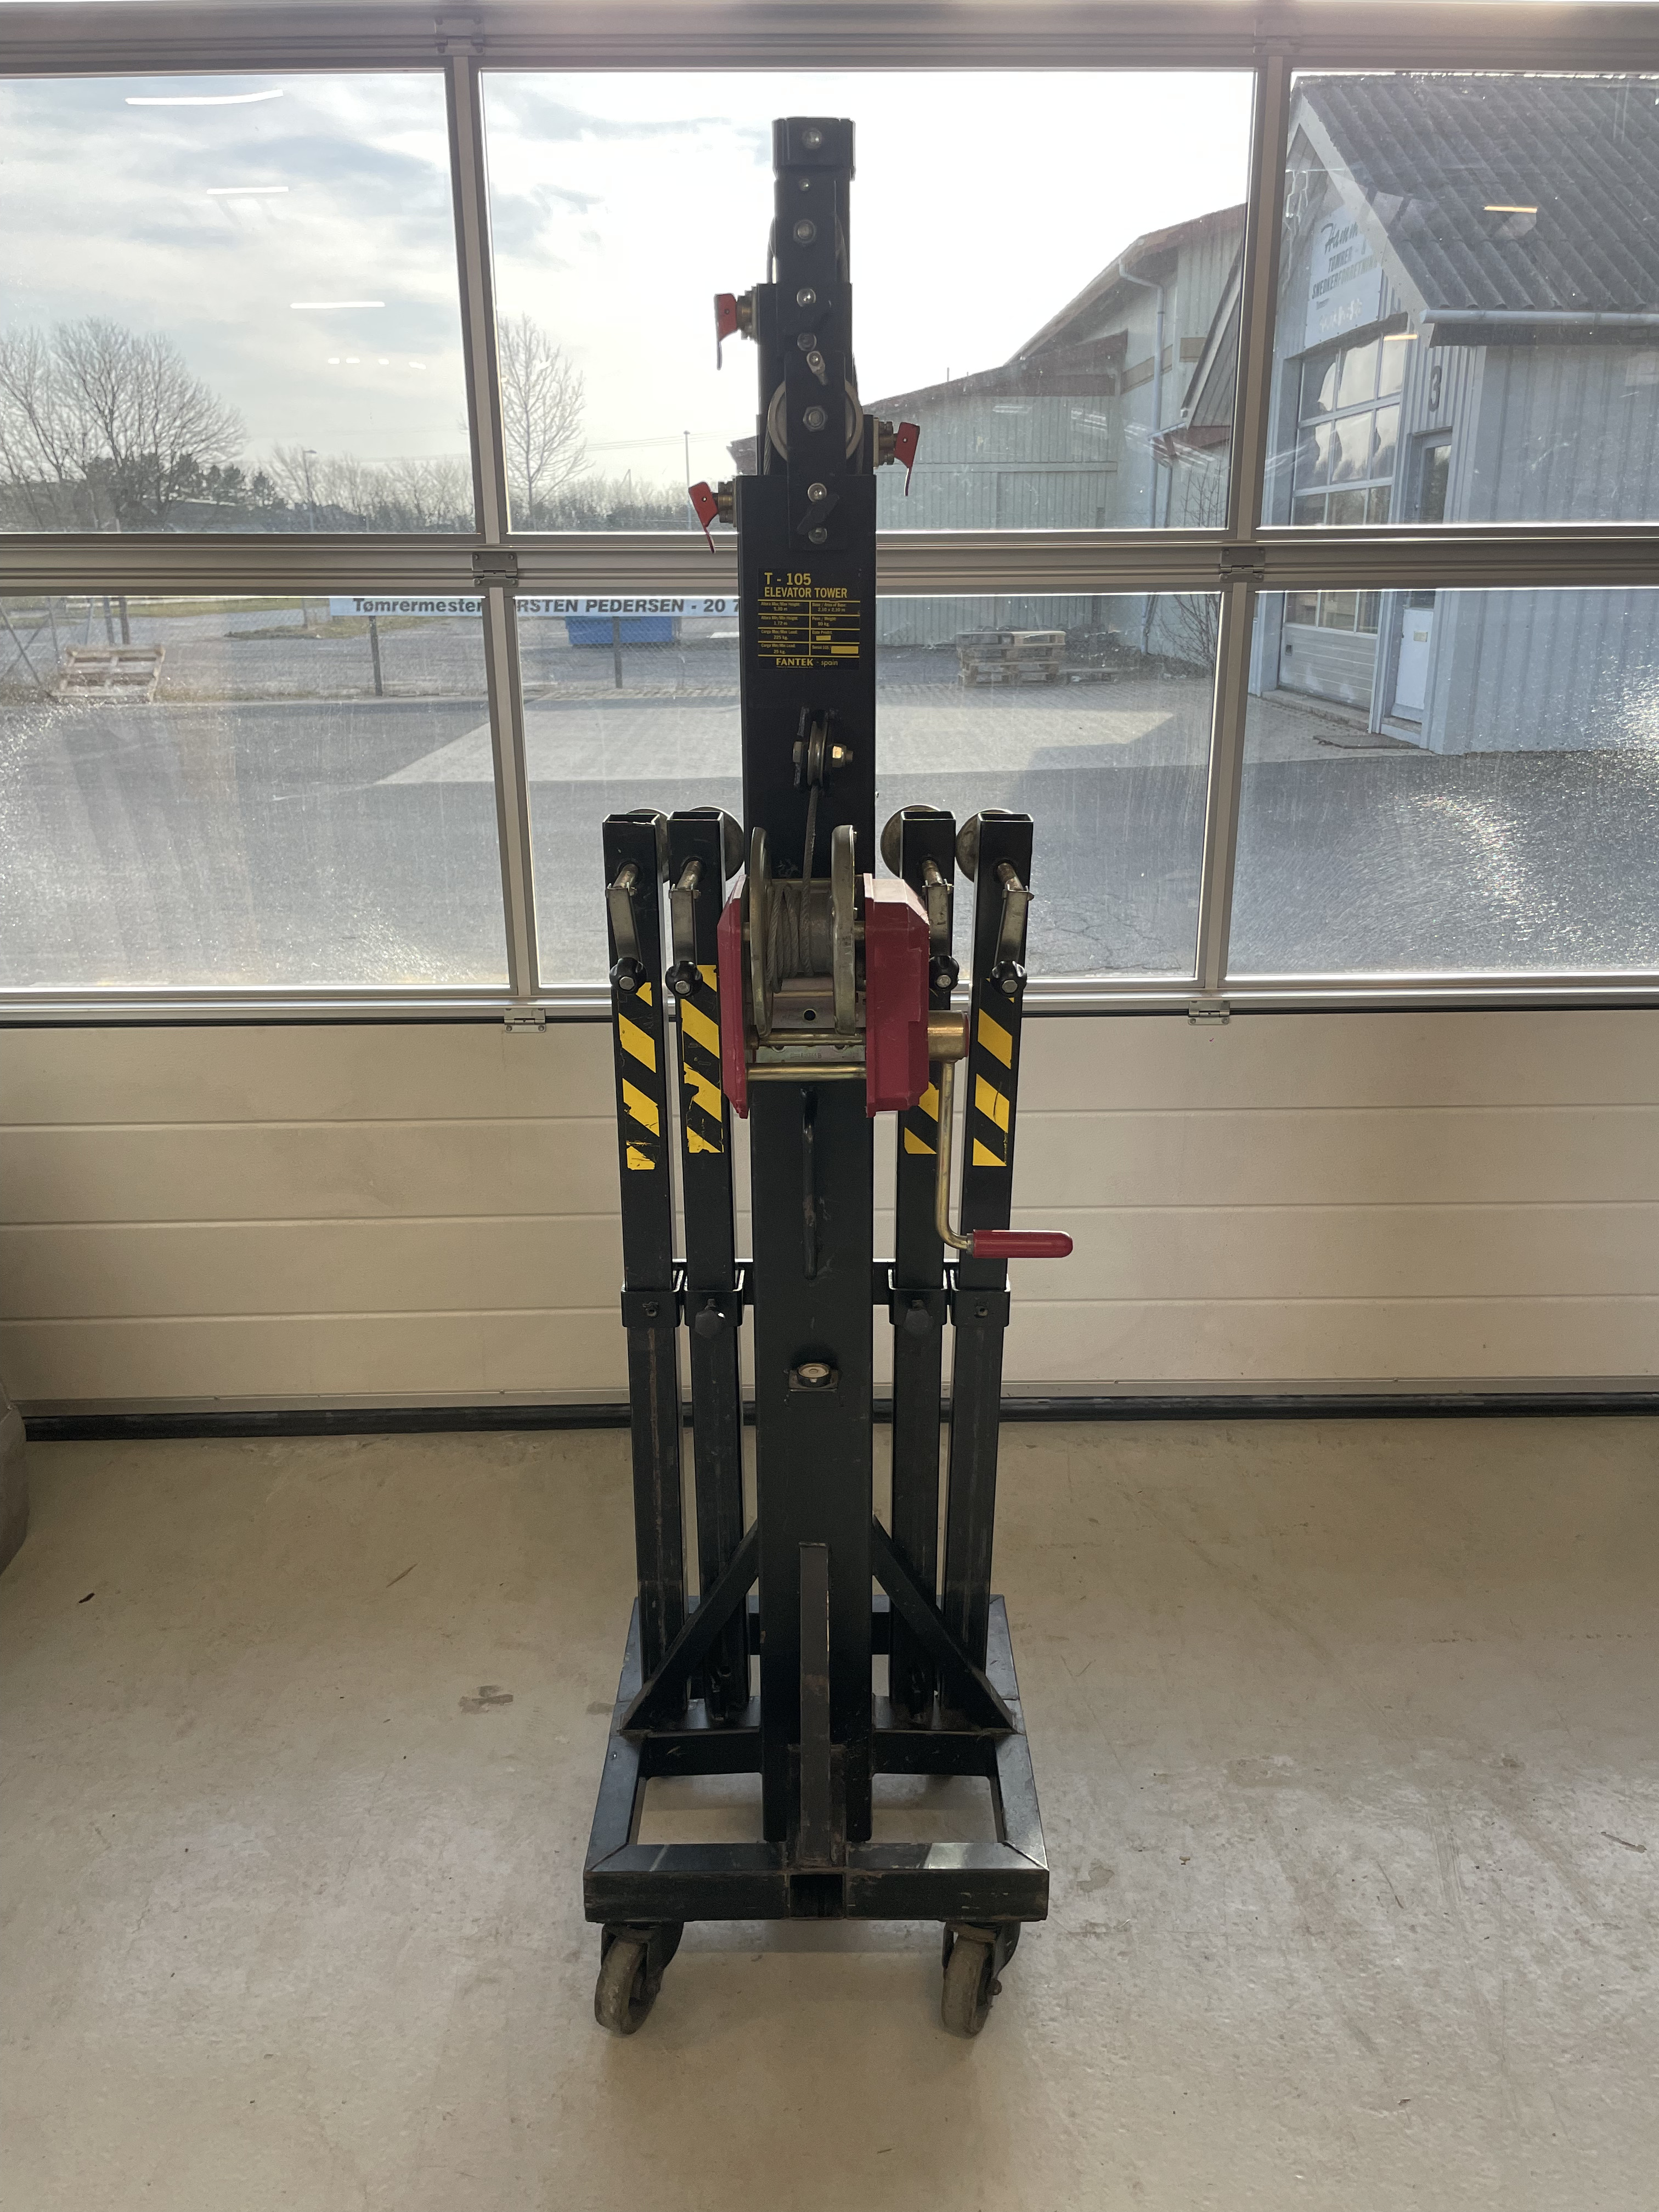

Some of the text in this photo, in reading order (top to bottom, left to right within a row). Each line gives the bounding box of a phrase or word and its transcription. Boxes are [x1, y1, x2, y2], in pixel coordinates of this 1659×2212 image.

[1428, 365, 1442, 412] 3
[764, 572, 773, 585] T
[786, 573, 811, 585] 105
[764, 586, 848, 599] ELEVATOR TOWER
[353, 598, 482, 613] Tømrermester
[585, 599, 685, 613] PEDERSEN
[703, 599, 726, 613] 20
[776, 658, 814, 666] FANTEK
[820, 659, 839, 668] spain
